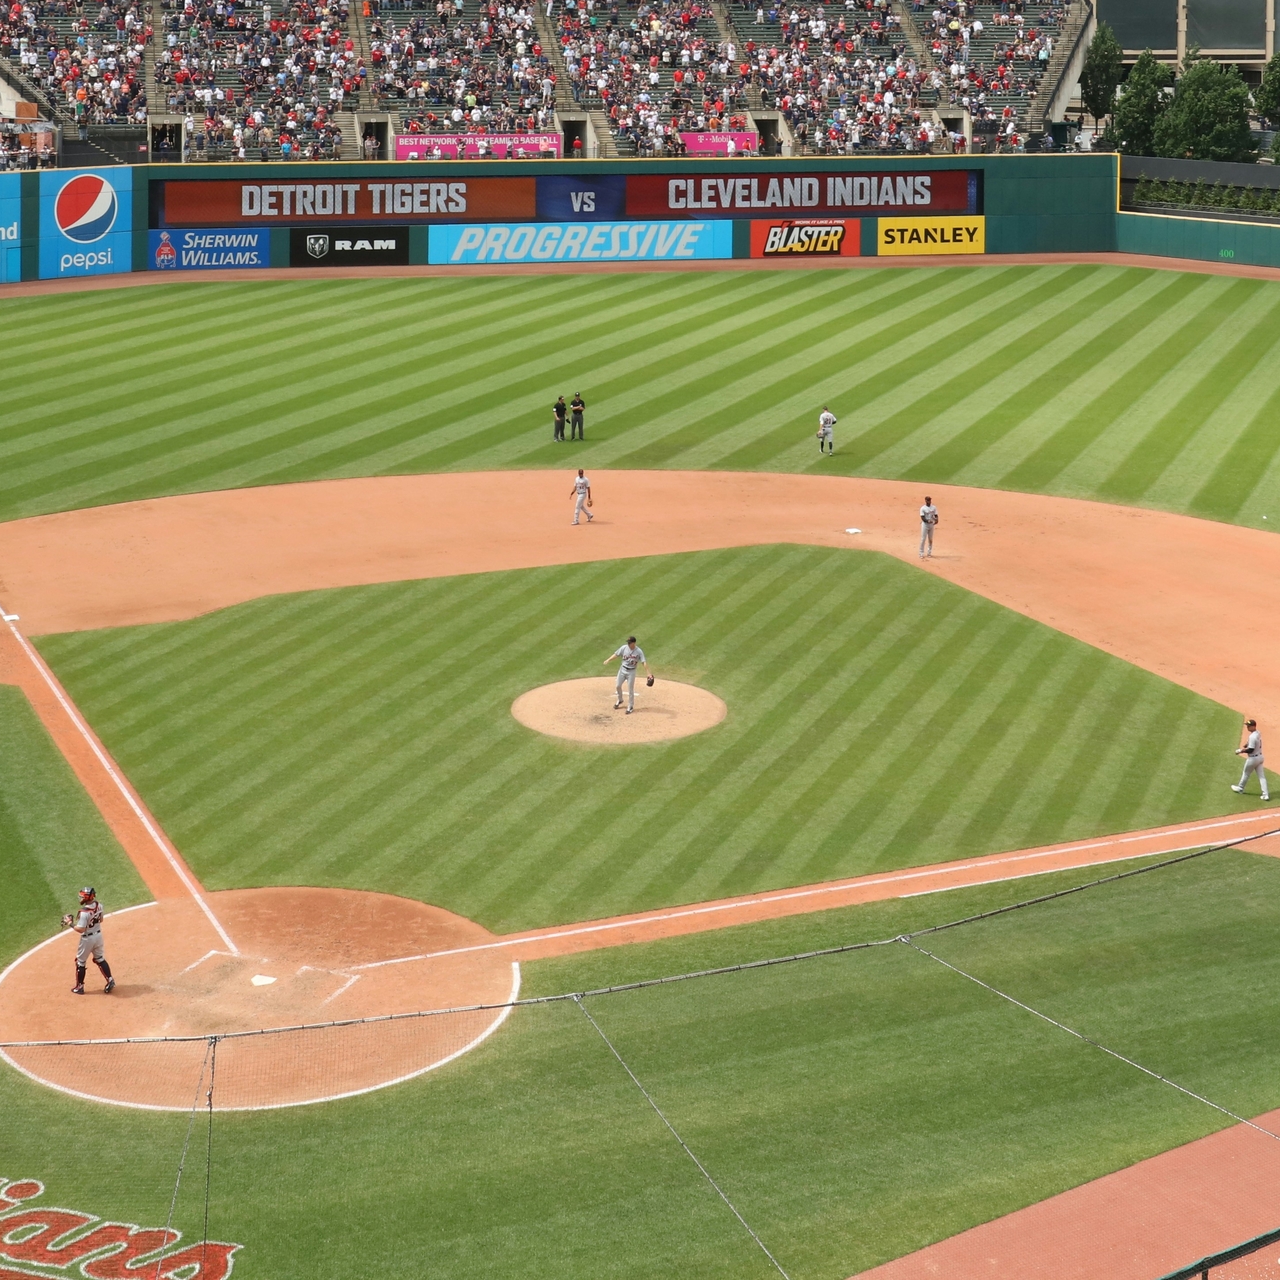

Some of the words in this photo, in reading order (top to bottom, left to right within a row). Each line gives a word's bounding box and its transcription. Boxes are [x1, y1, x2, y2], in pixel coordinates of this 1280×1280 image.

[420, 137, 457, 145] NETWORK
[241, 183, 360, 216] DETROIT
[367, 182, 467, 214] TIGERS
[570, 191, 596, 212] VS
[668, 176, 819, 209] CLEVELAND
[826, 176, 931, 206] INDIANS
[183, 232, 258, 248] SHERWIN
[335, 239, 396, 250] RAM
[451, 223, 704, 261] PROGRESSIVE
[884, 227, 978, 245] STANLEY
[60, 248, 112, 271] pepsi
